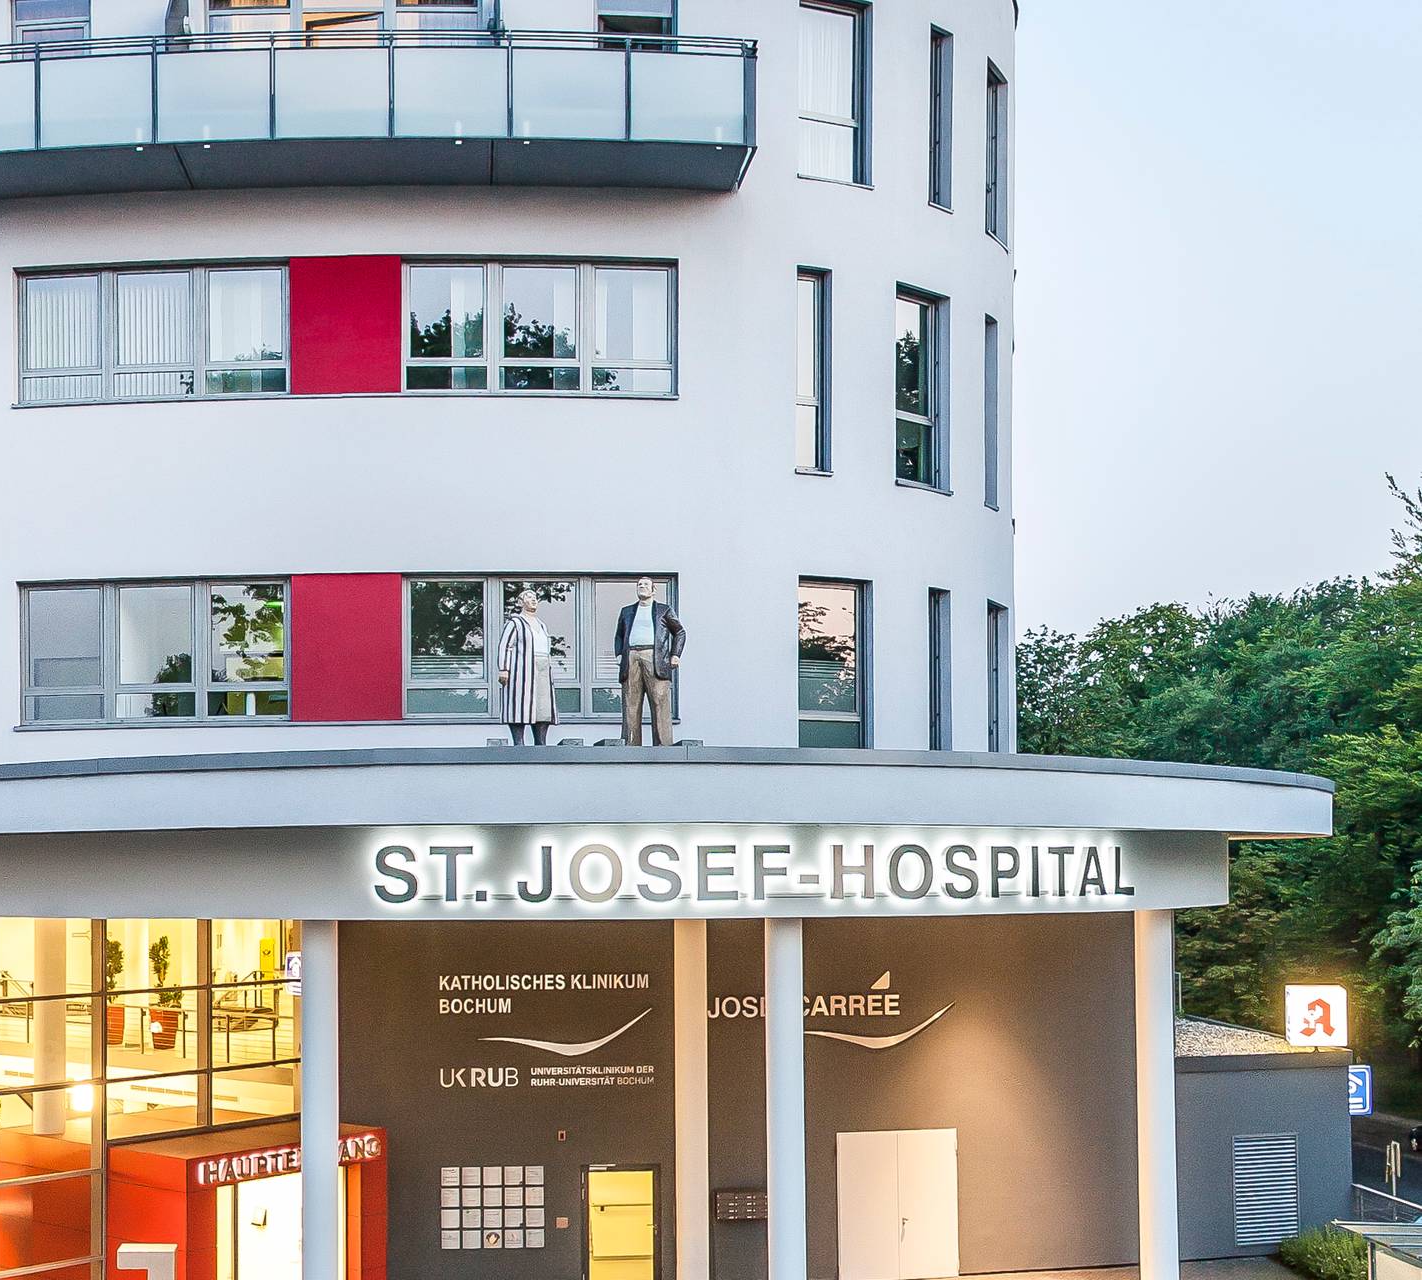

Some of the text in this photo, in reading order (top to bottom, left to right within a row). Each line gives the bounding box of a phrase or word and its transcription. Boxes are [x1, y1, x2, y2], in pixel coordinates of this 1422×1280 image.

[374, 843, 1135, 903] ST. JOSEF-HOSPITAL
[439, 973, 650, 991] KATHOLISCHES KLINIKUM
[439, 997, 512, 1014] BOCHUM
[707, 996, 766, 1018] JOS
[530, 1065, 655, 1076] UNIVERSITÄTSKLINIKUM DER
[530, 1076, 655, 1087] RUHR-UNIVERSITÄT BOCHUM
